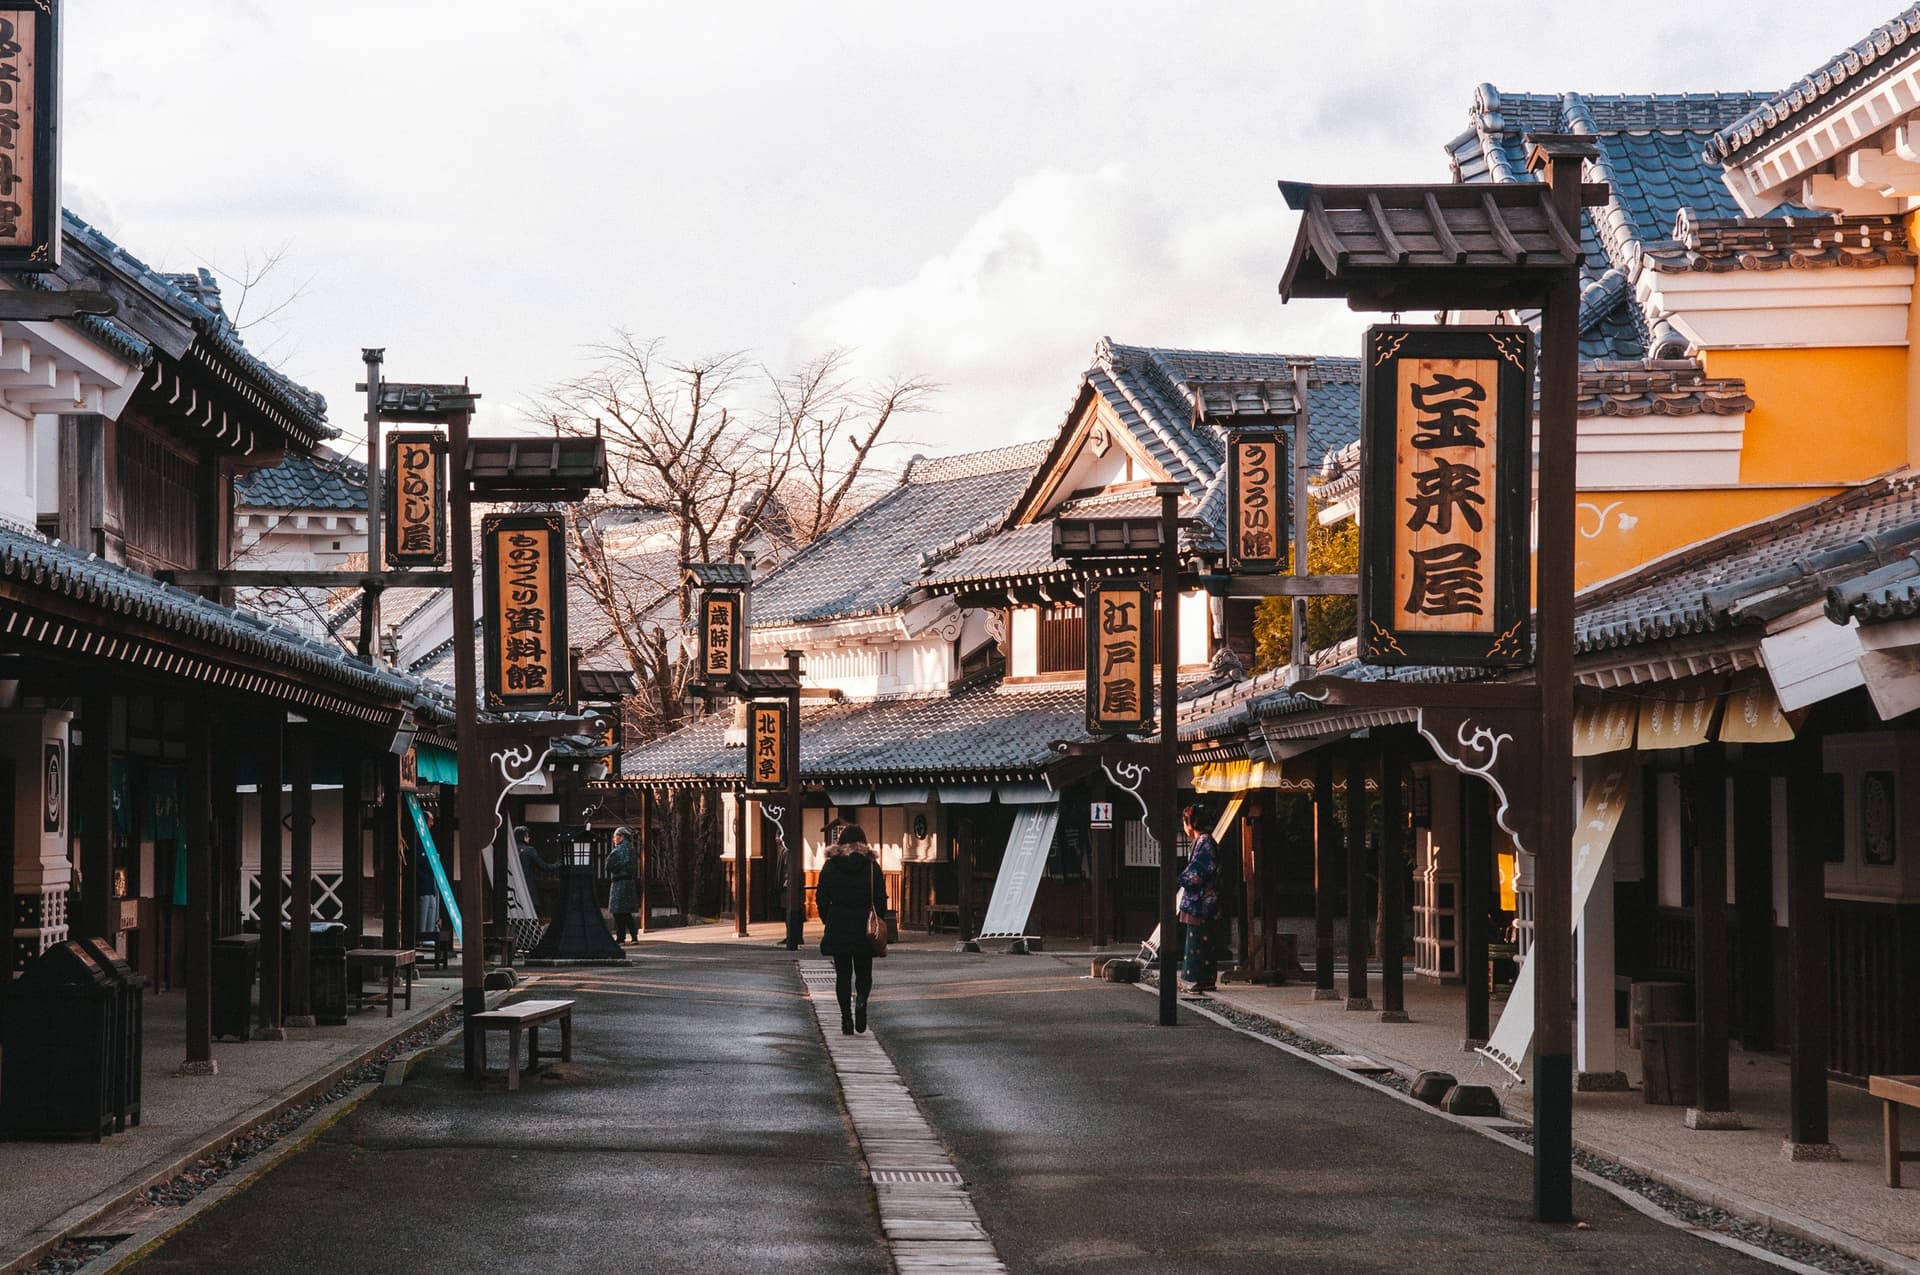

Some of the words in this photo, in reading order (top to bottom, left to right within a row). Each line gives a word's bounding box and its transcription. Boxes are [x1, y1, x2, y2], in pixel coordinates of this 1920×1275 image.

[401, 446, 431, 552] わらじ屋
[1241, 445, 1272, 558] うつろい館
[1404, 373, 1487, 616] 宝来屋
[505, 534, 547, 690] ものづくり資料館
[1102, 599, 1138, 713] 江戸屋
[758, 713, 777, 780] 北京亭
